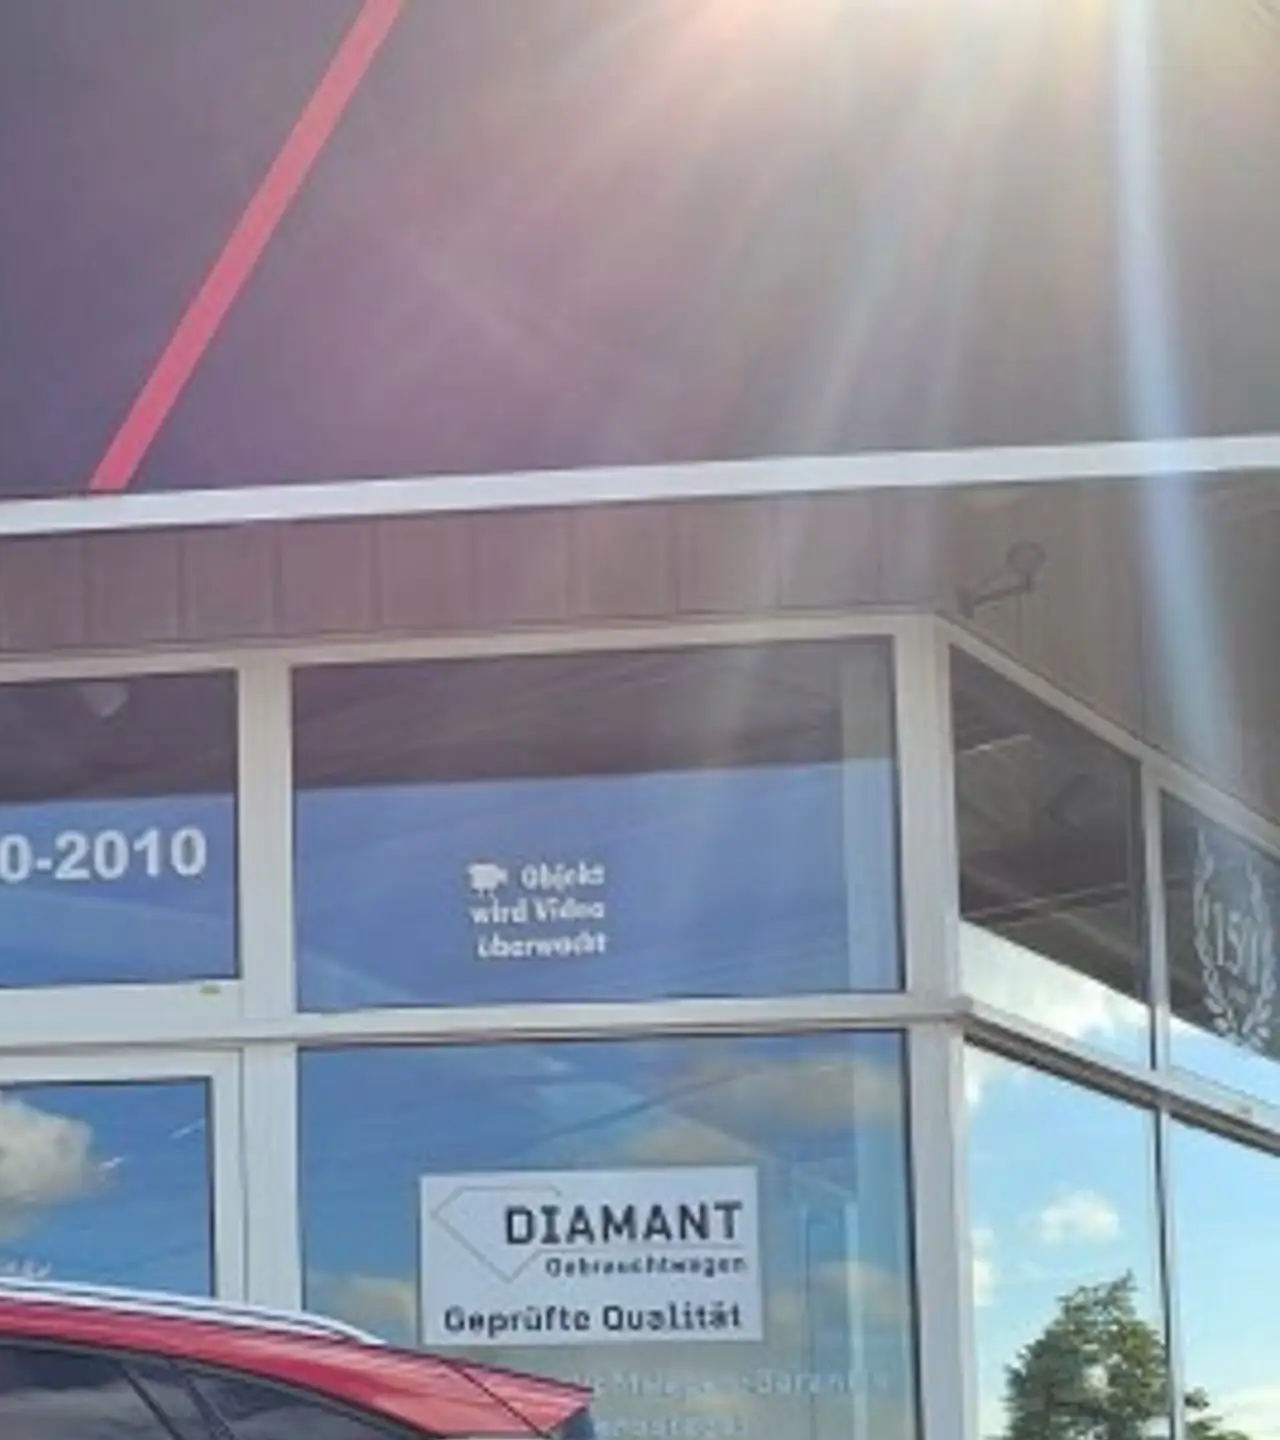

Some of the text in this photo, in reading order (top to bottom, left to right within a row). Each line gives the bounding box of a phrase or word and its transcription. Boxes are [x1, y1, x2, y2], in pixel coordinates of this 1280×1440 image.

[520, 859, 606, 891] Objekt
[469, 897, 605, 925] wird Video
[504, 1200, 743, 1246] DIAMANT
[545, 1256, 748, 1277] Gebrauchtwagen
[443, 1301, 741, 1338] Geprüfte Qualität
